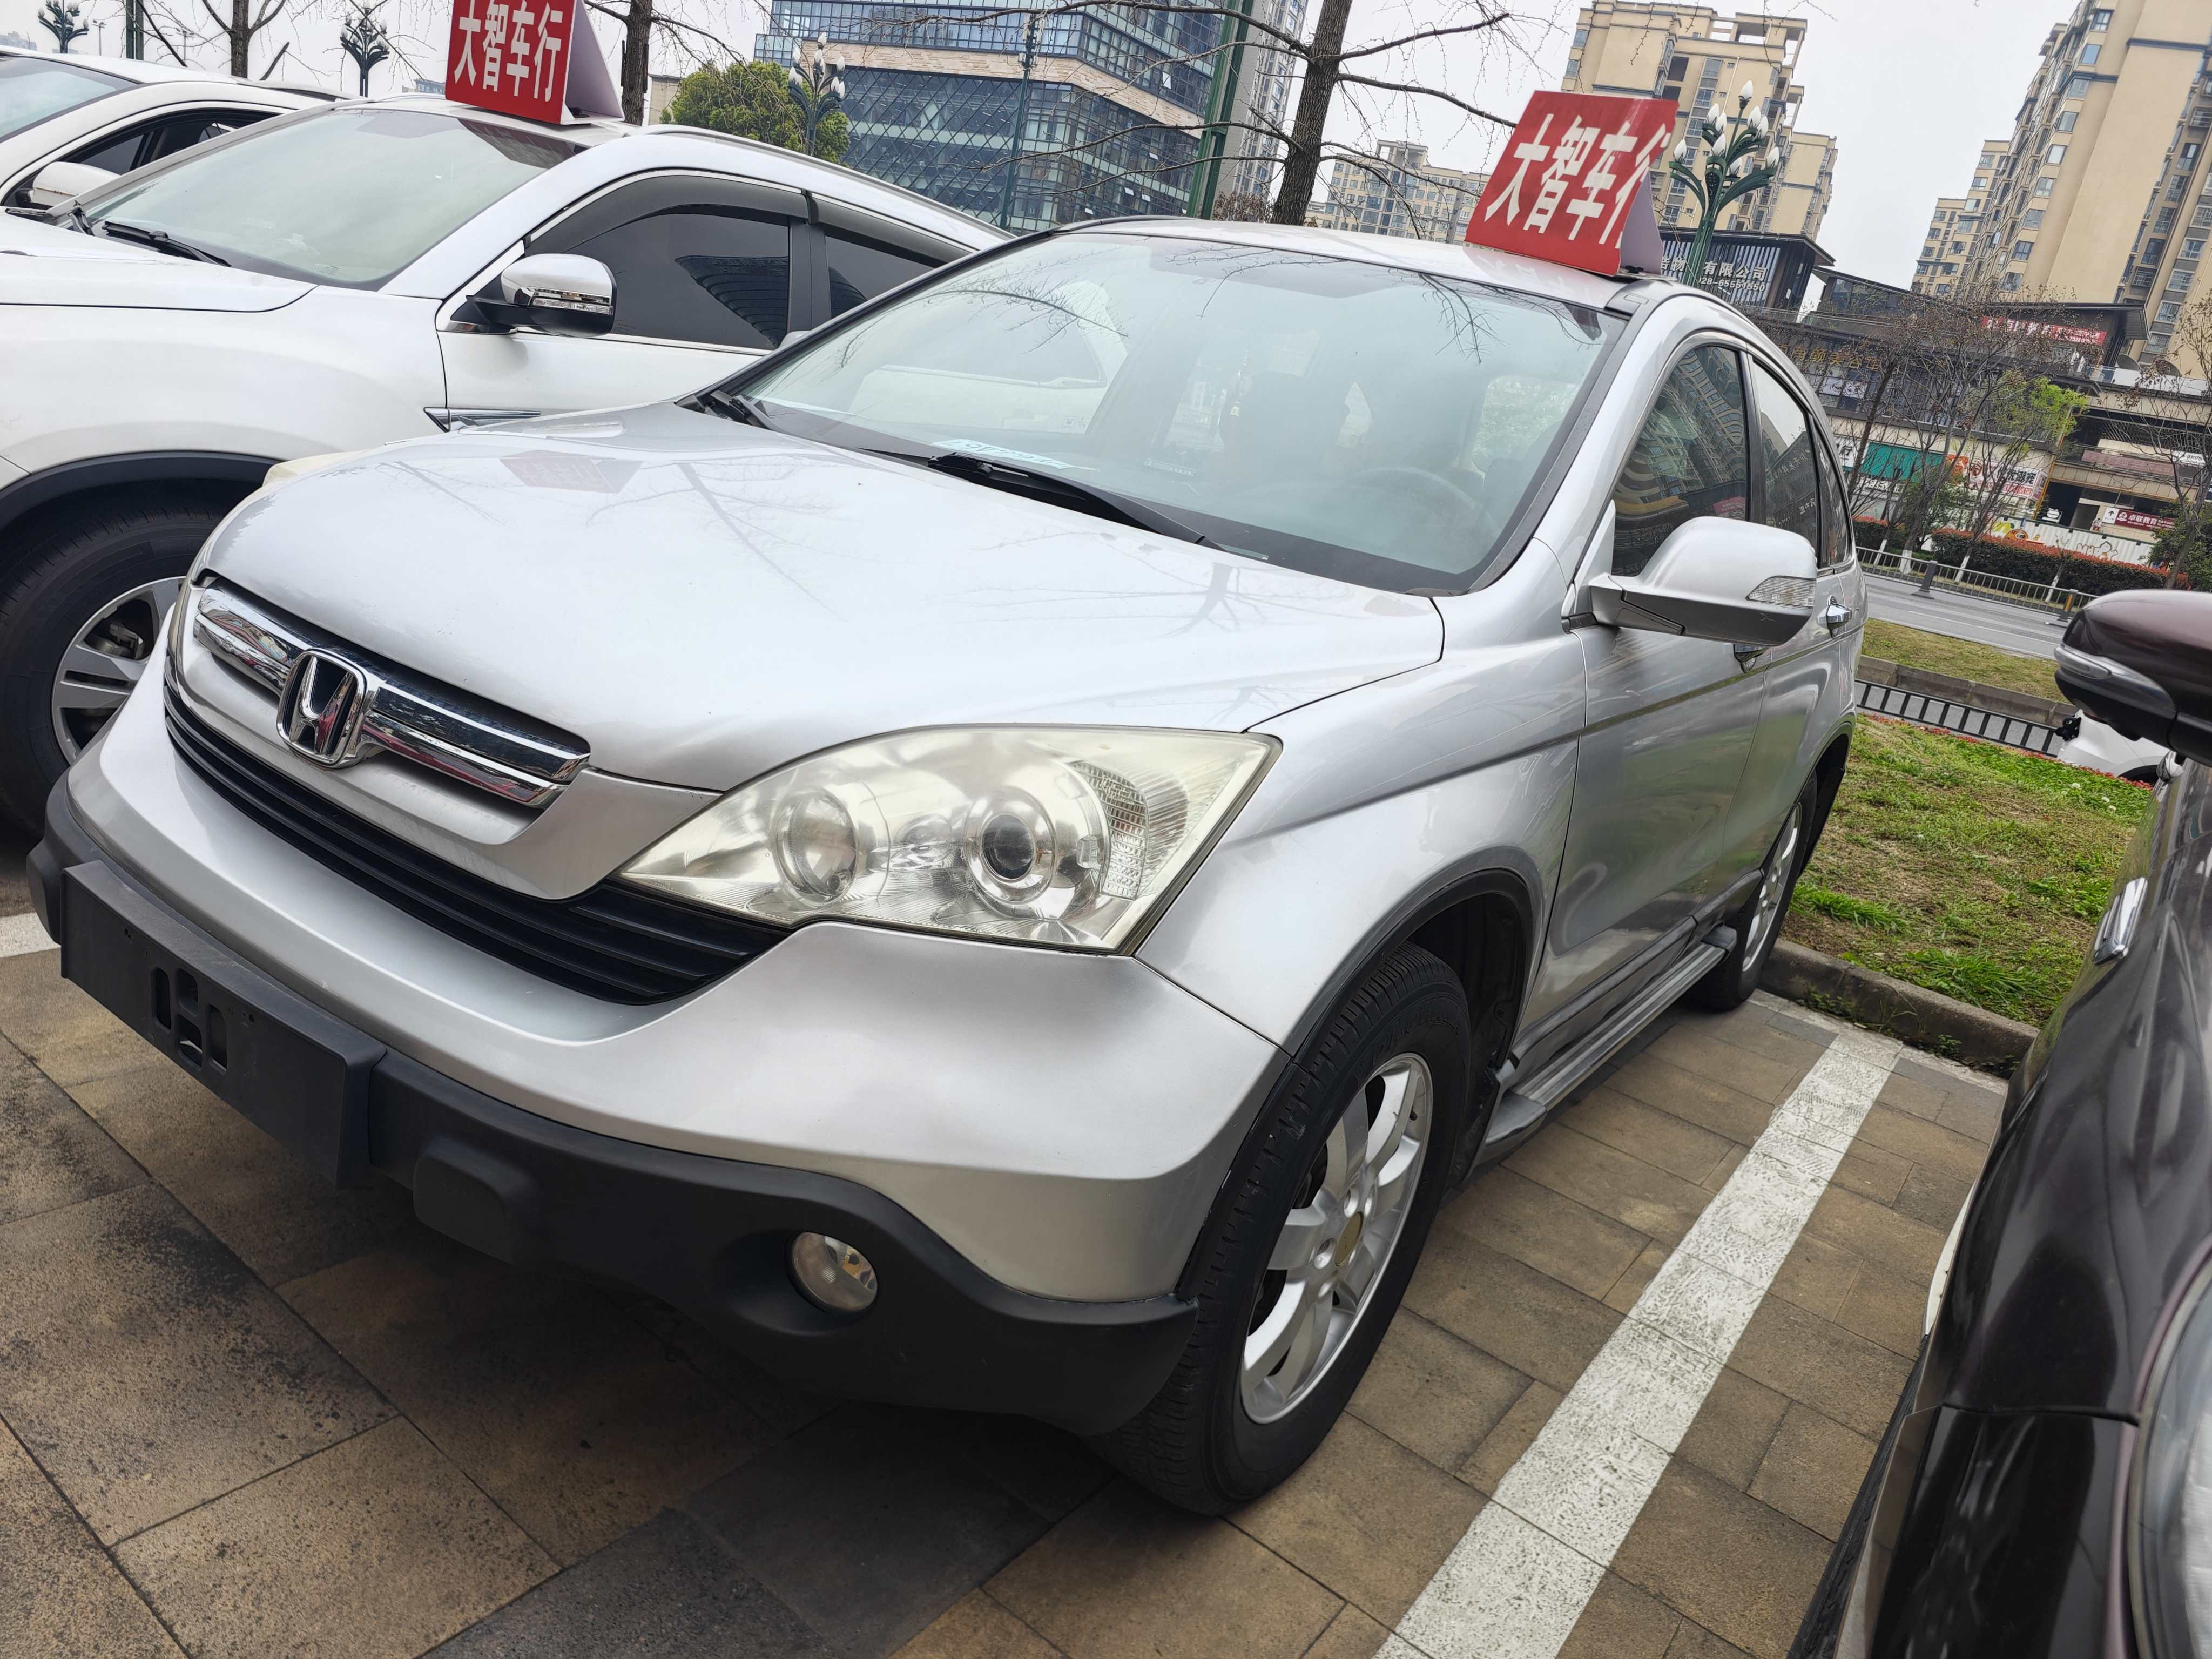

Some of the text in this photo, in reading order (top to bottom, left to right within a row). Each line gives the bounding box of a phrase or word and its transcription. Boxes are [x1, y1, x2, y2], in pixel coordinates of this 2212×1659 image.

[454, 0, 563, 102] 大智车行
[2128, 514, 2157, 525] 卓联教育
